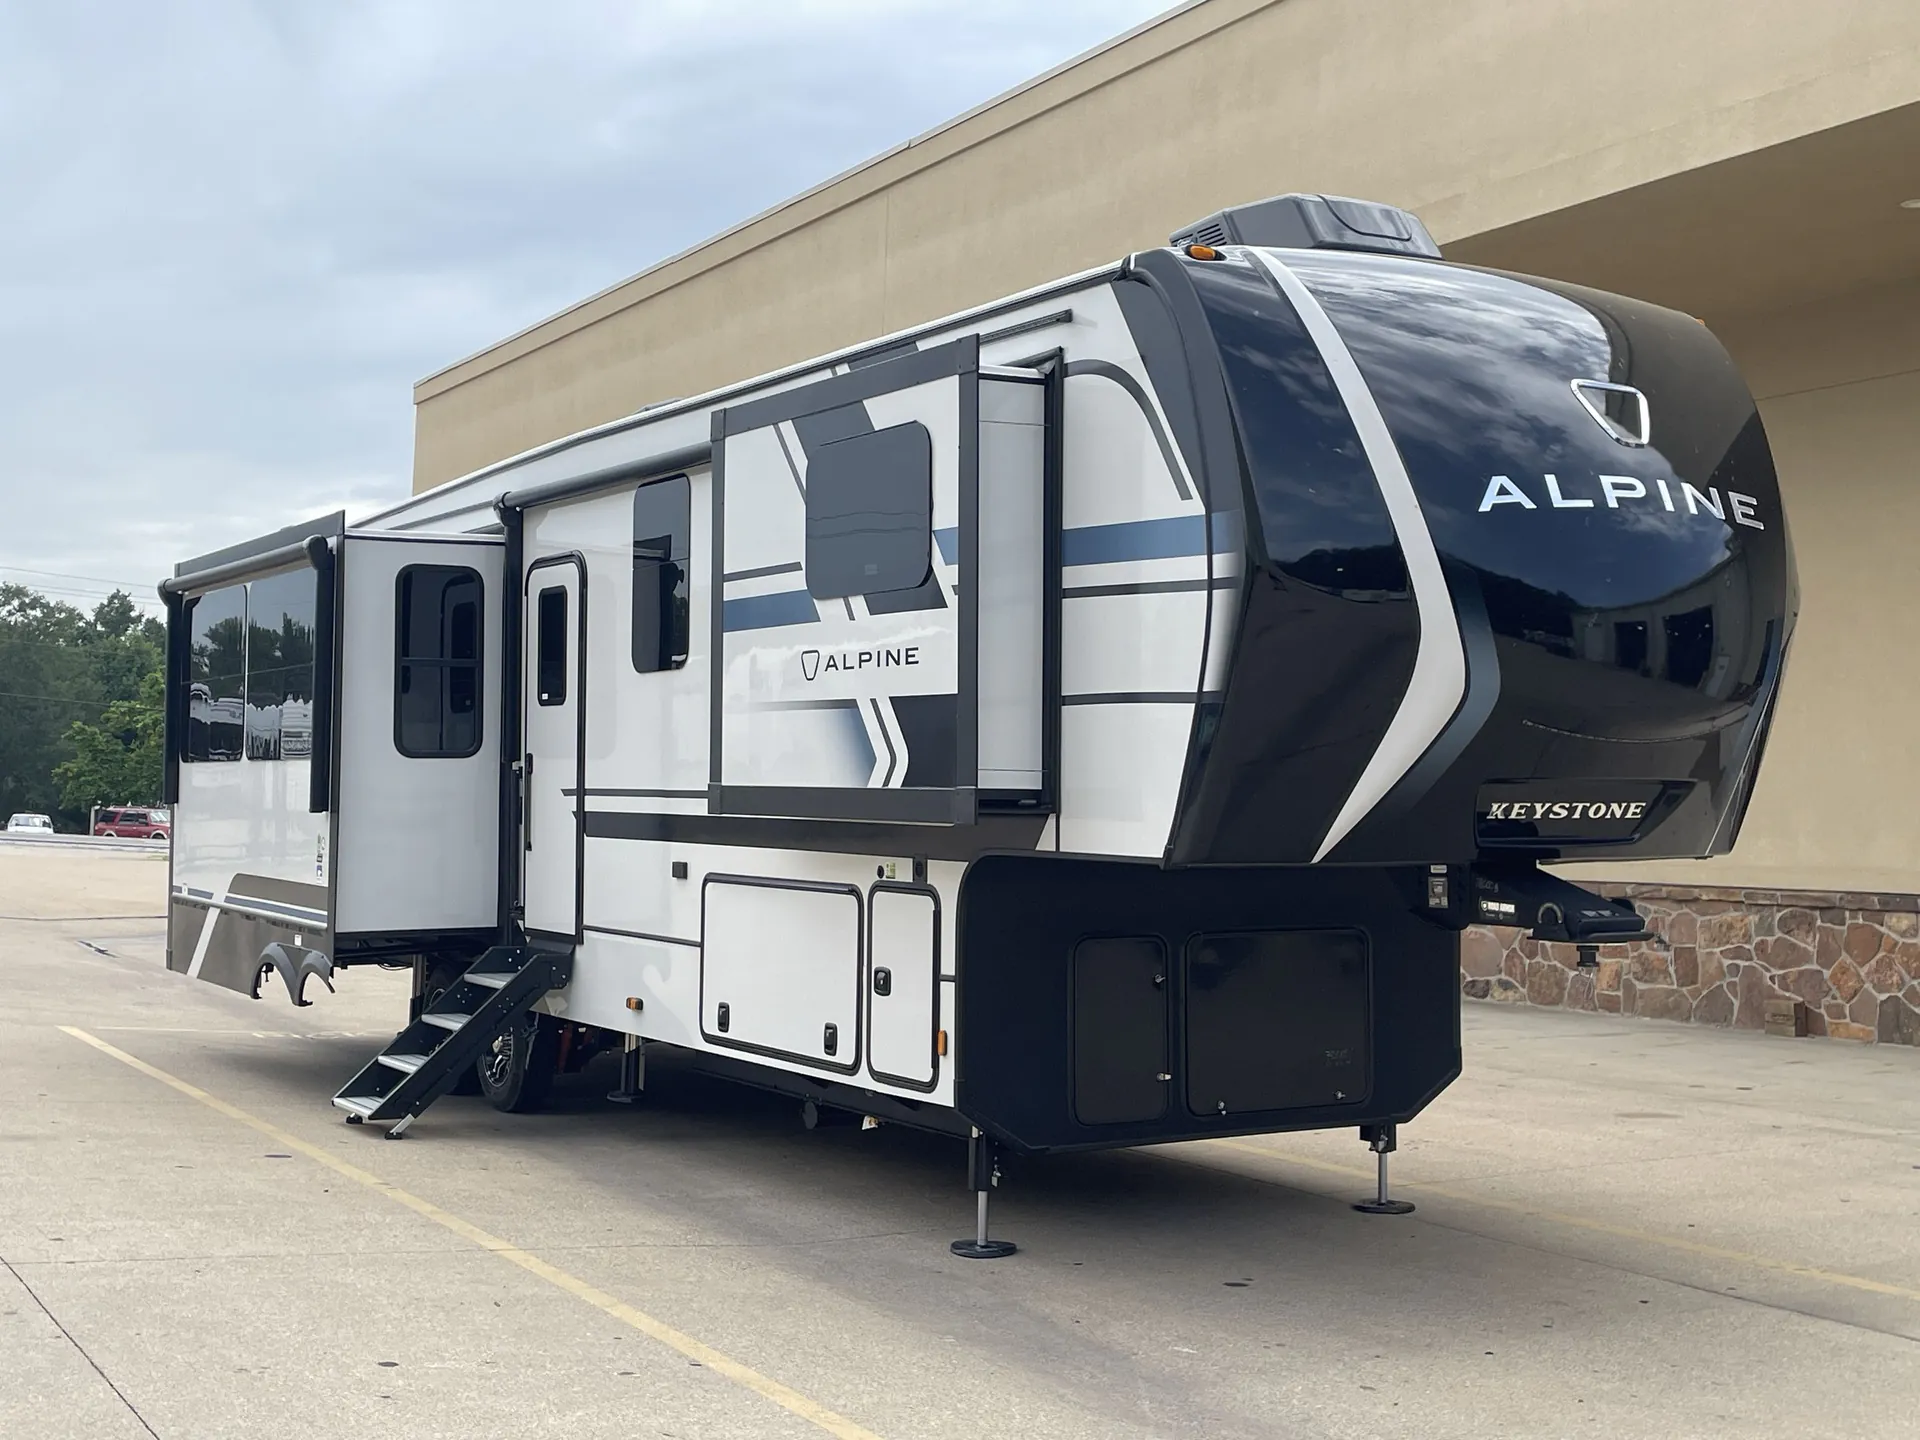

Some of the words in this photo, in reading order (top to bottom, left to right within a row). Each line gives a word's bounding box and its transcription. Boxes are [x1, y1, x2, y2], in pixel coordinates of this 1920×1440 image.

[1478, 473, 1765, 531] ALPINE
[824, 646, 920, 673] ALPINE
[1486, 802, 1647, 820] KEYSTONE
